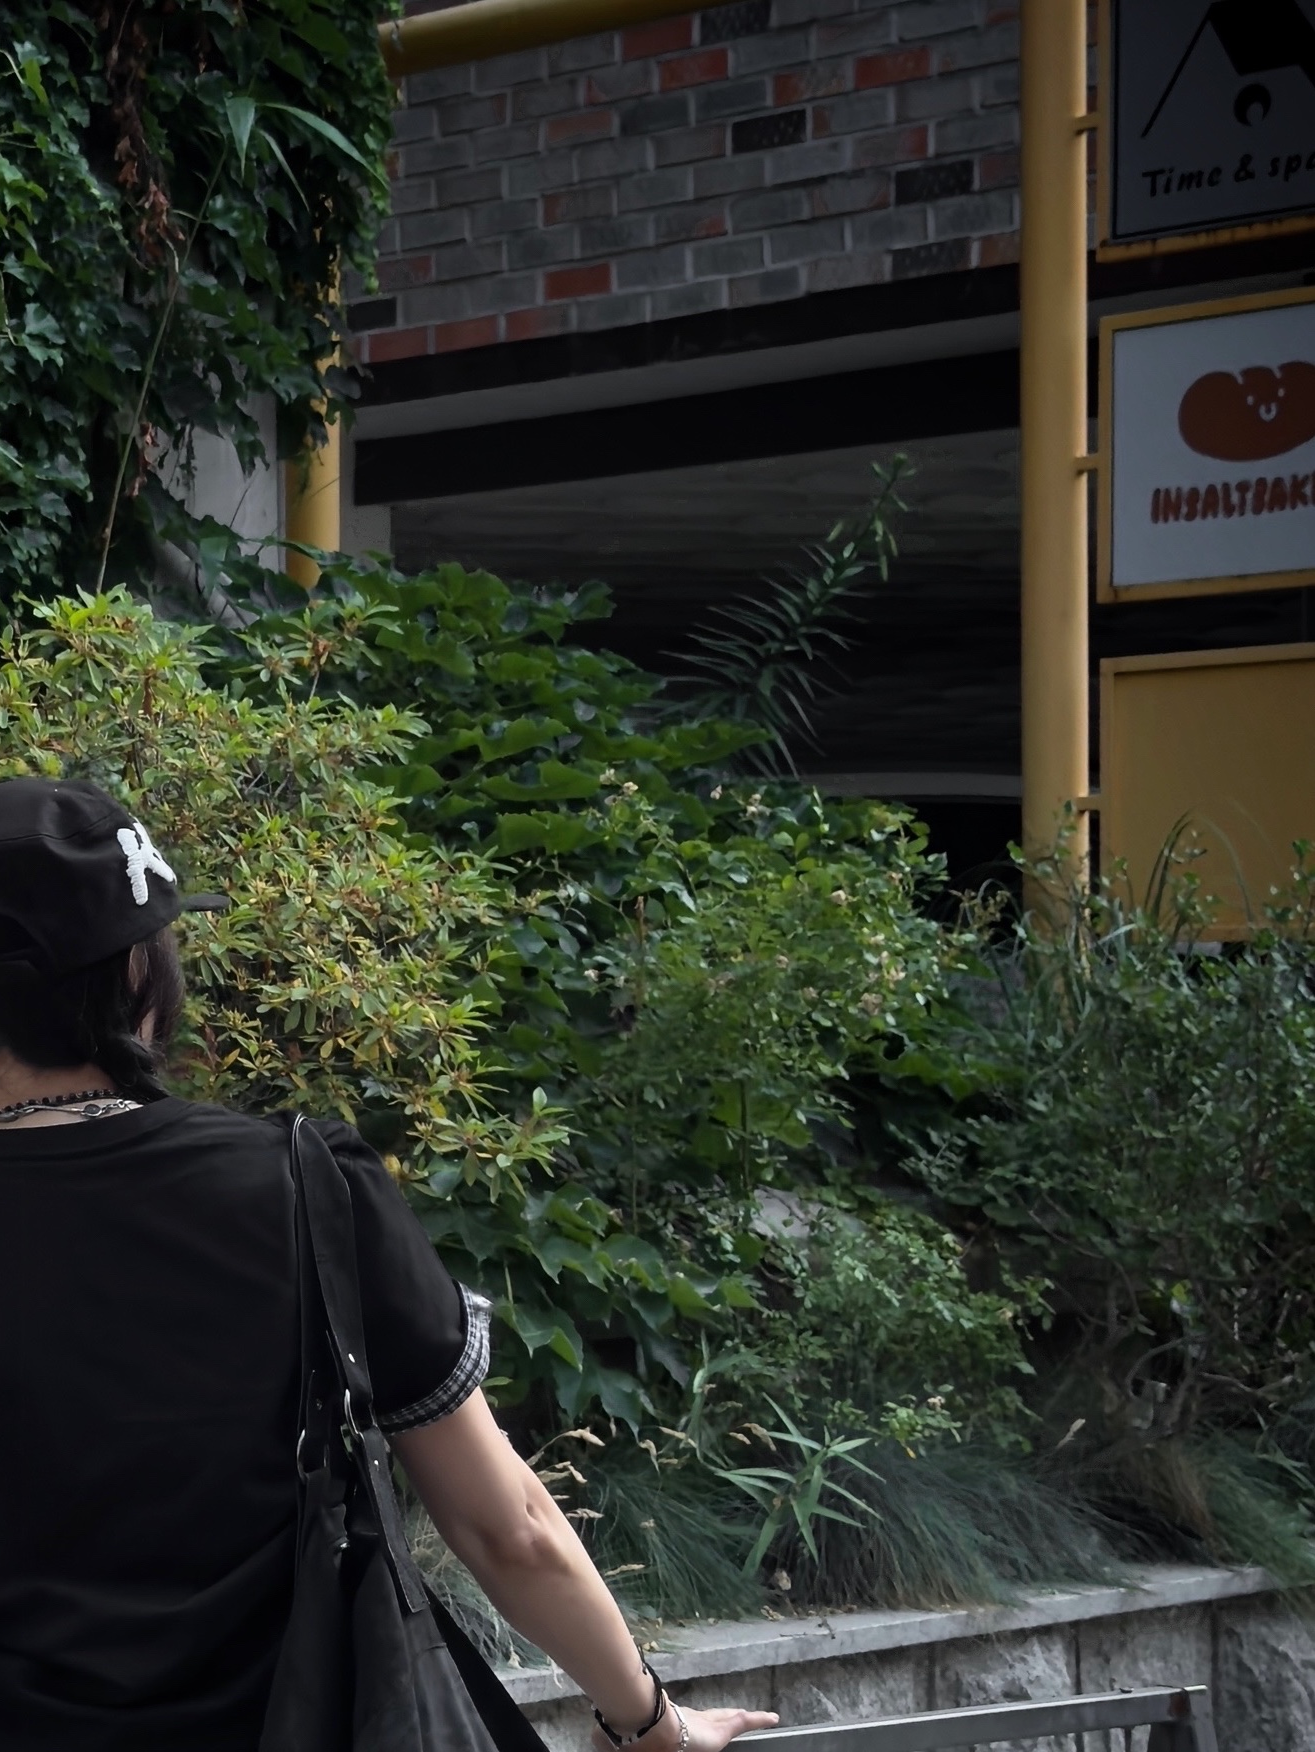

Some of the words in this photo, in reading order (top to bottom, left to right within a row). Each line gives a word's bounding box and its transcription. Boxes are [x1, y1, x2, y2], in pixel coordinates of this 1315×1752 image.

[1141, 167, 1222, 197] Time
[1234, 154, 1256, 182] &
[1151, 471, 1315, 524] INSALTBAK
